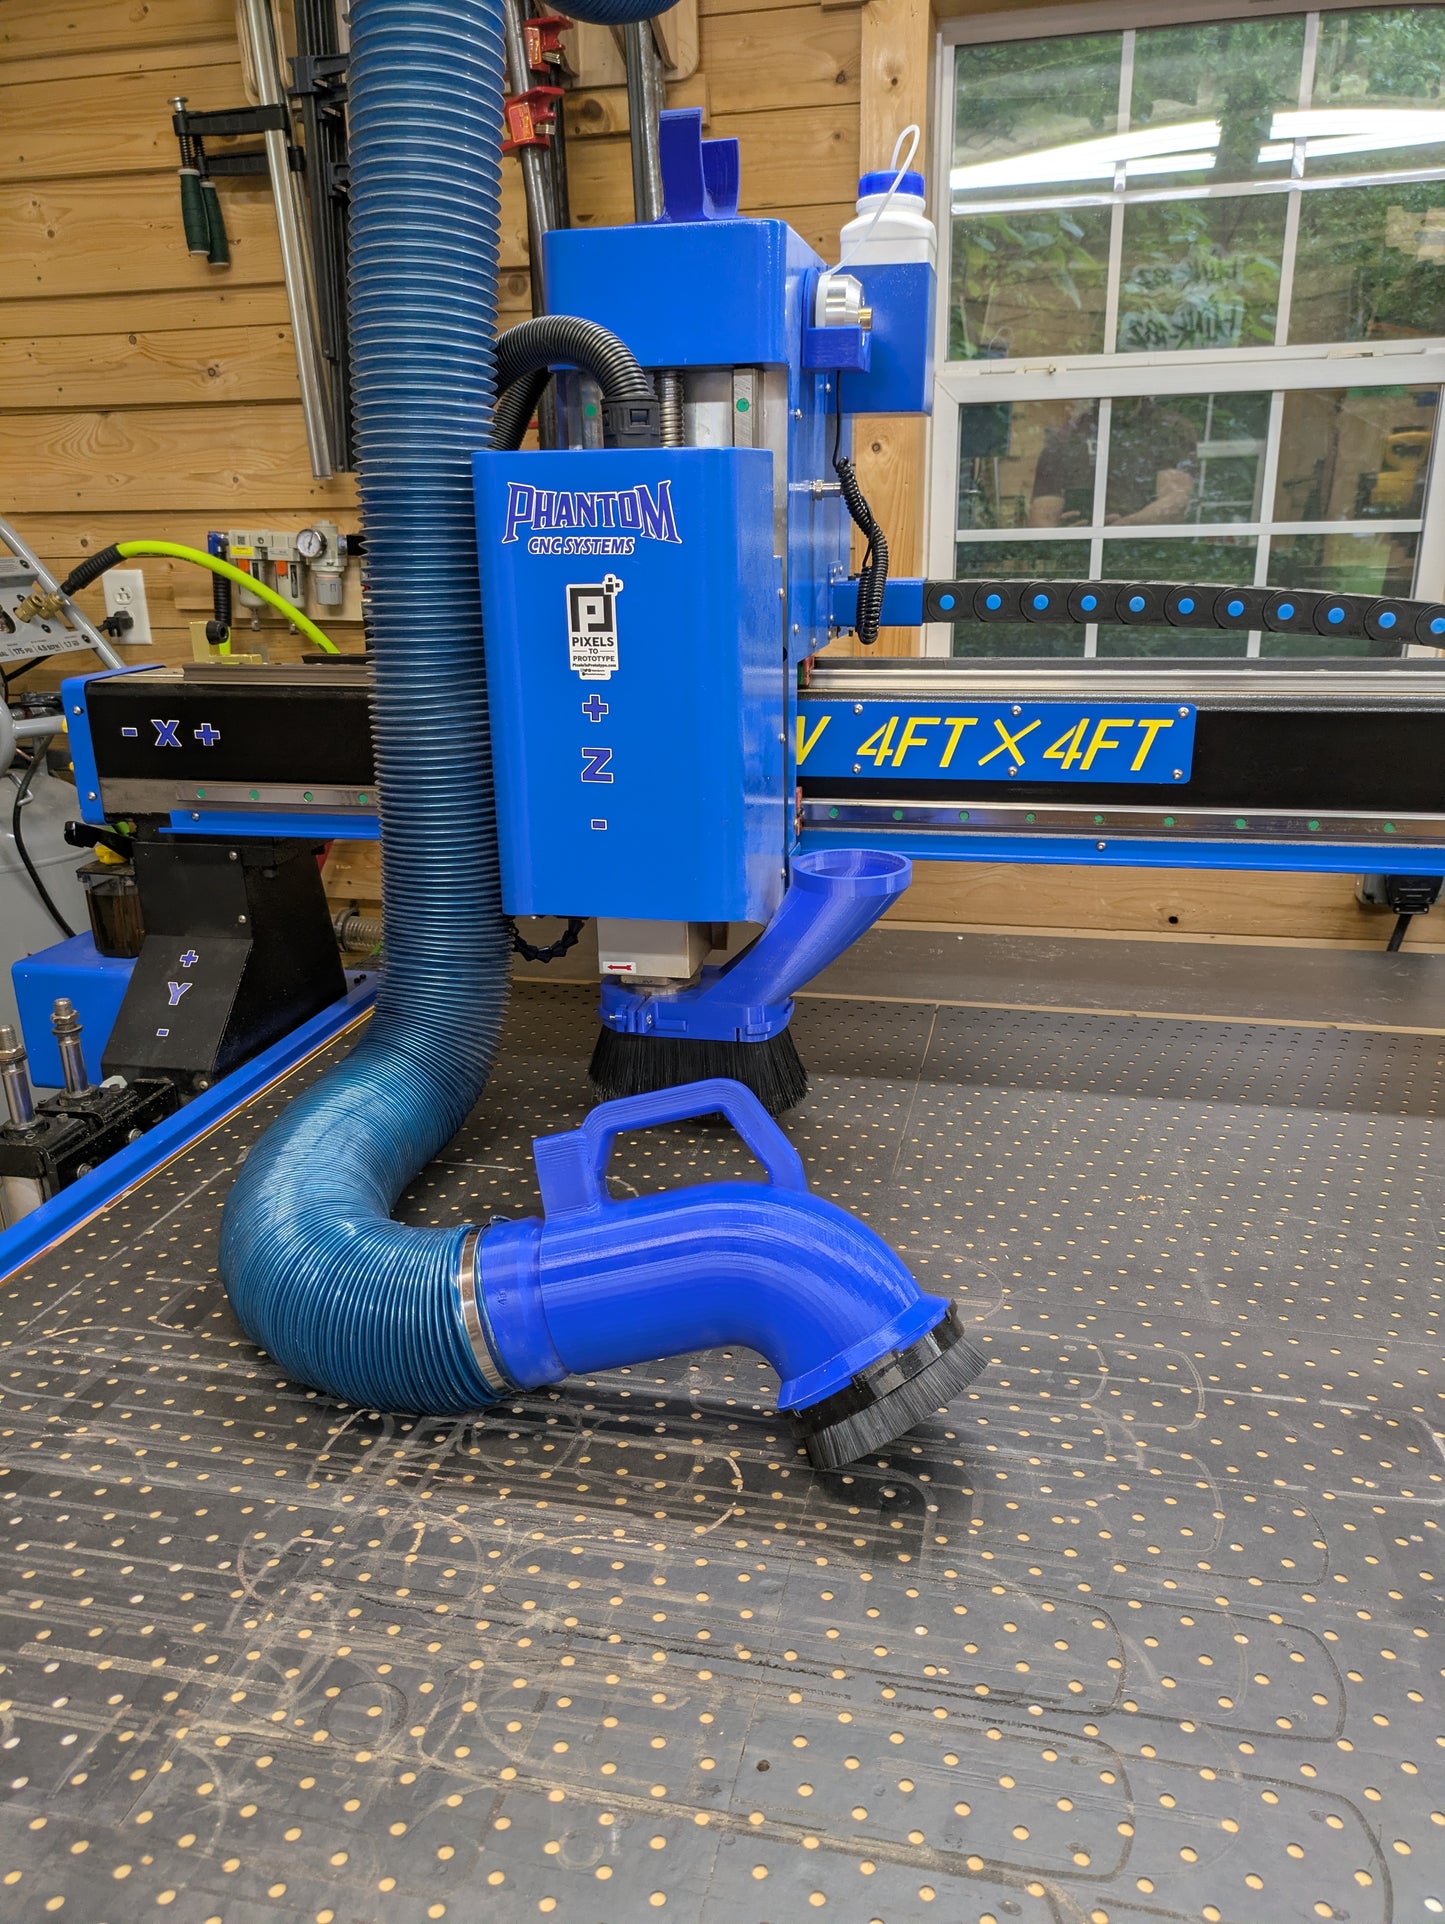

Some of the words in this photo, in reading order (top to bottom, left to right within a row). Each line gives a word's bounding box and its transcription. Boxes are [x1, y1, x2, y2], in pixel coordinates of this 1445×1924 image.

[502, 480, 682, 544] PHANTOM
[528, 536, 562, 554] CNC
[564, 536, 635, 554] SYSTEMS
[572, 637, 614, 646] PIXELS
[150, 719, 182, 747] X
[856, 716, 979, 768] 4FT
[978, 719, 1042, 767] X
[1042, 718, 1174, 771] 4FT
[581, 747, 614, 784] Z
[168, 981, 193, 1005] Y
